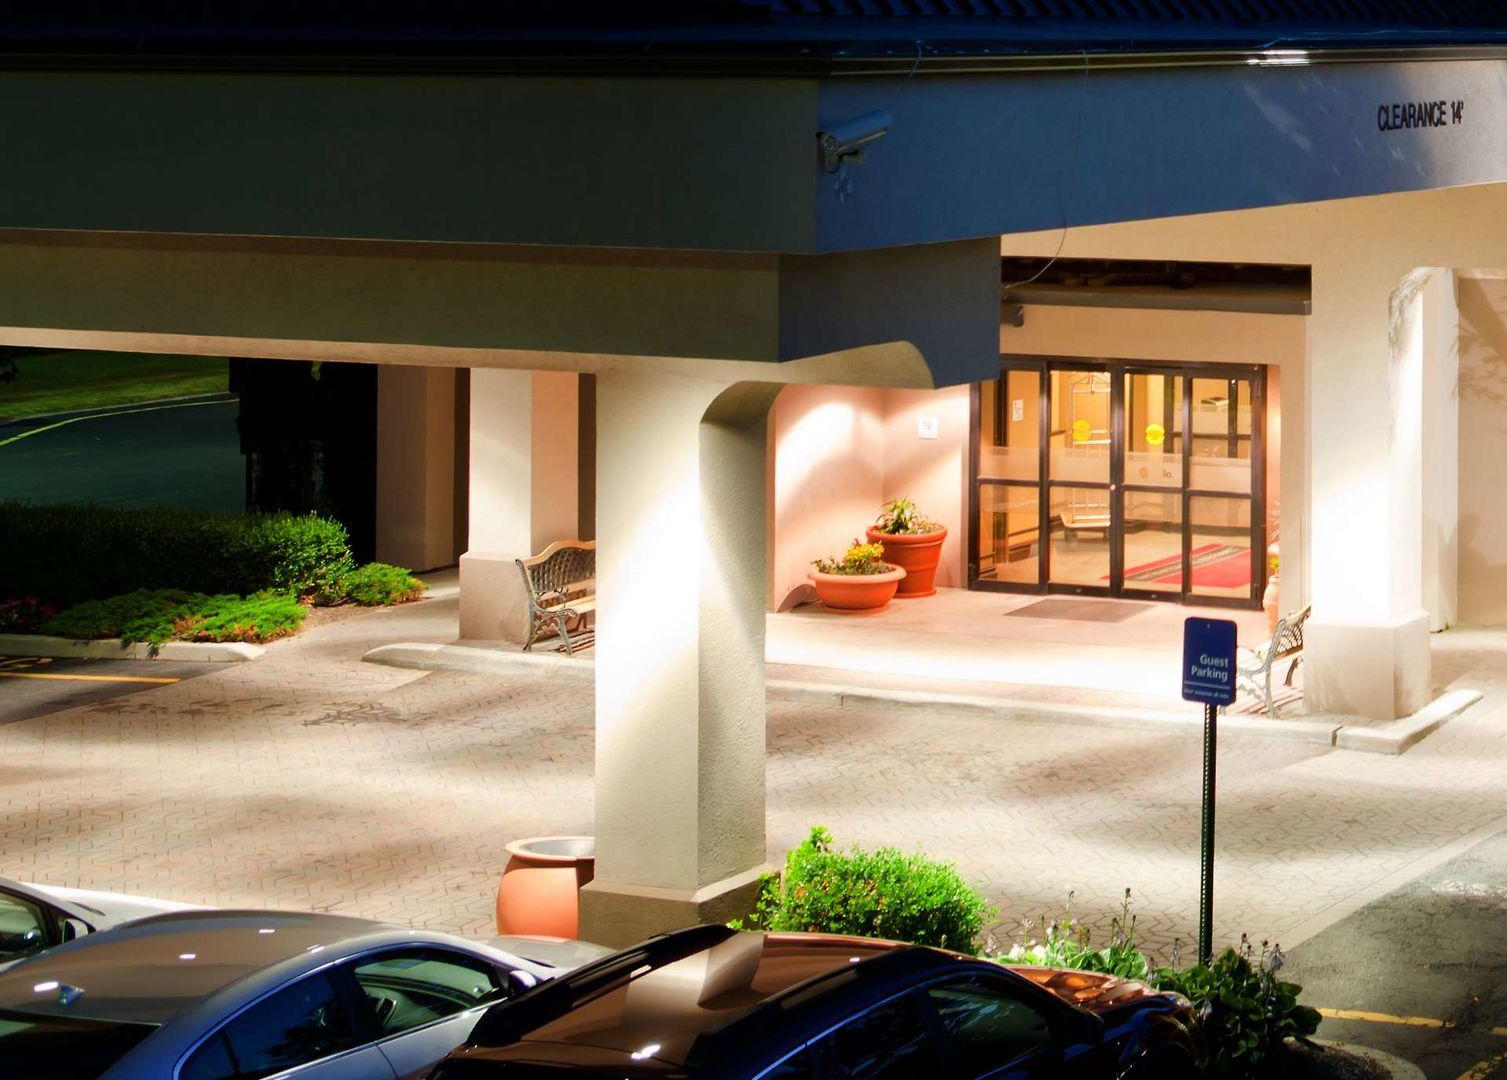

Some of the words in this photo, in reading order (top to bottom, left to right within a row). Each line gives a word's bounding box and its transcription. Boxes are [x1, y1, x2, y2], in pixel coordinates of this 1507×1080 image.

[1377, 101, 1447, 131] CLEARANCE
[1200, 654, 1229, 668] Guest
[1191, 665, 1228, 682] Parking
